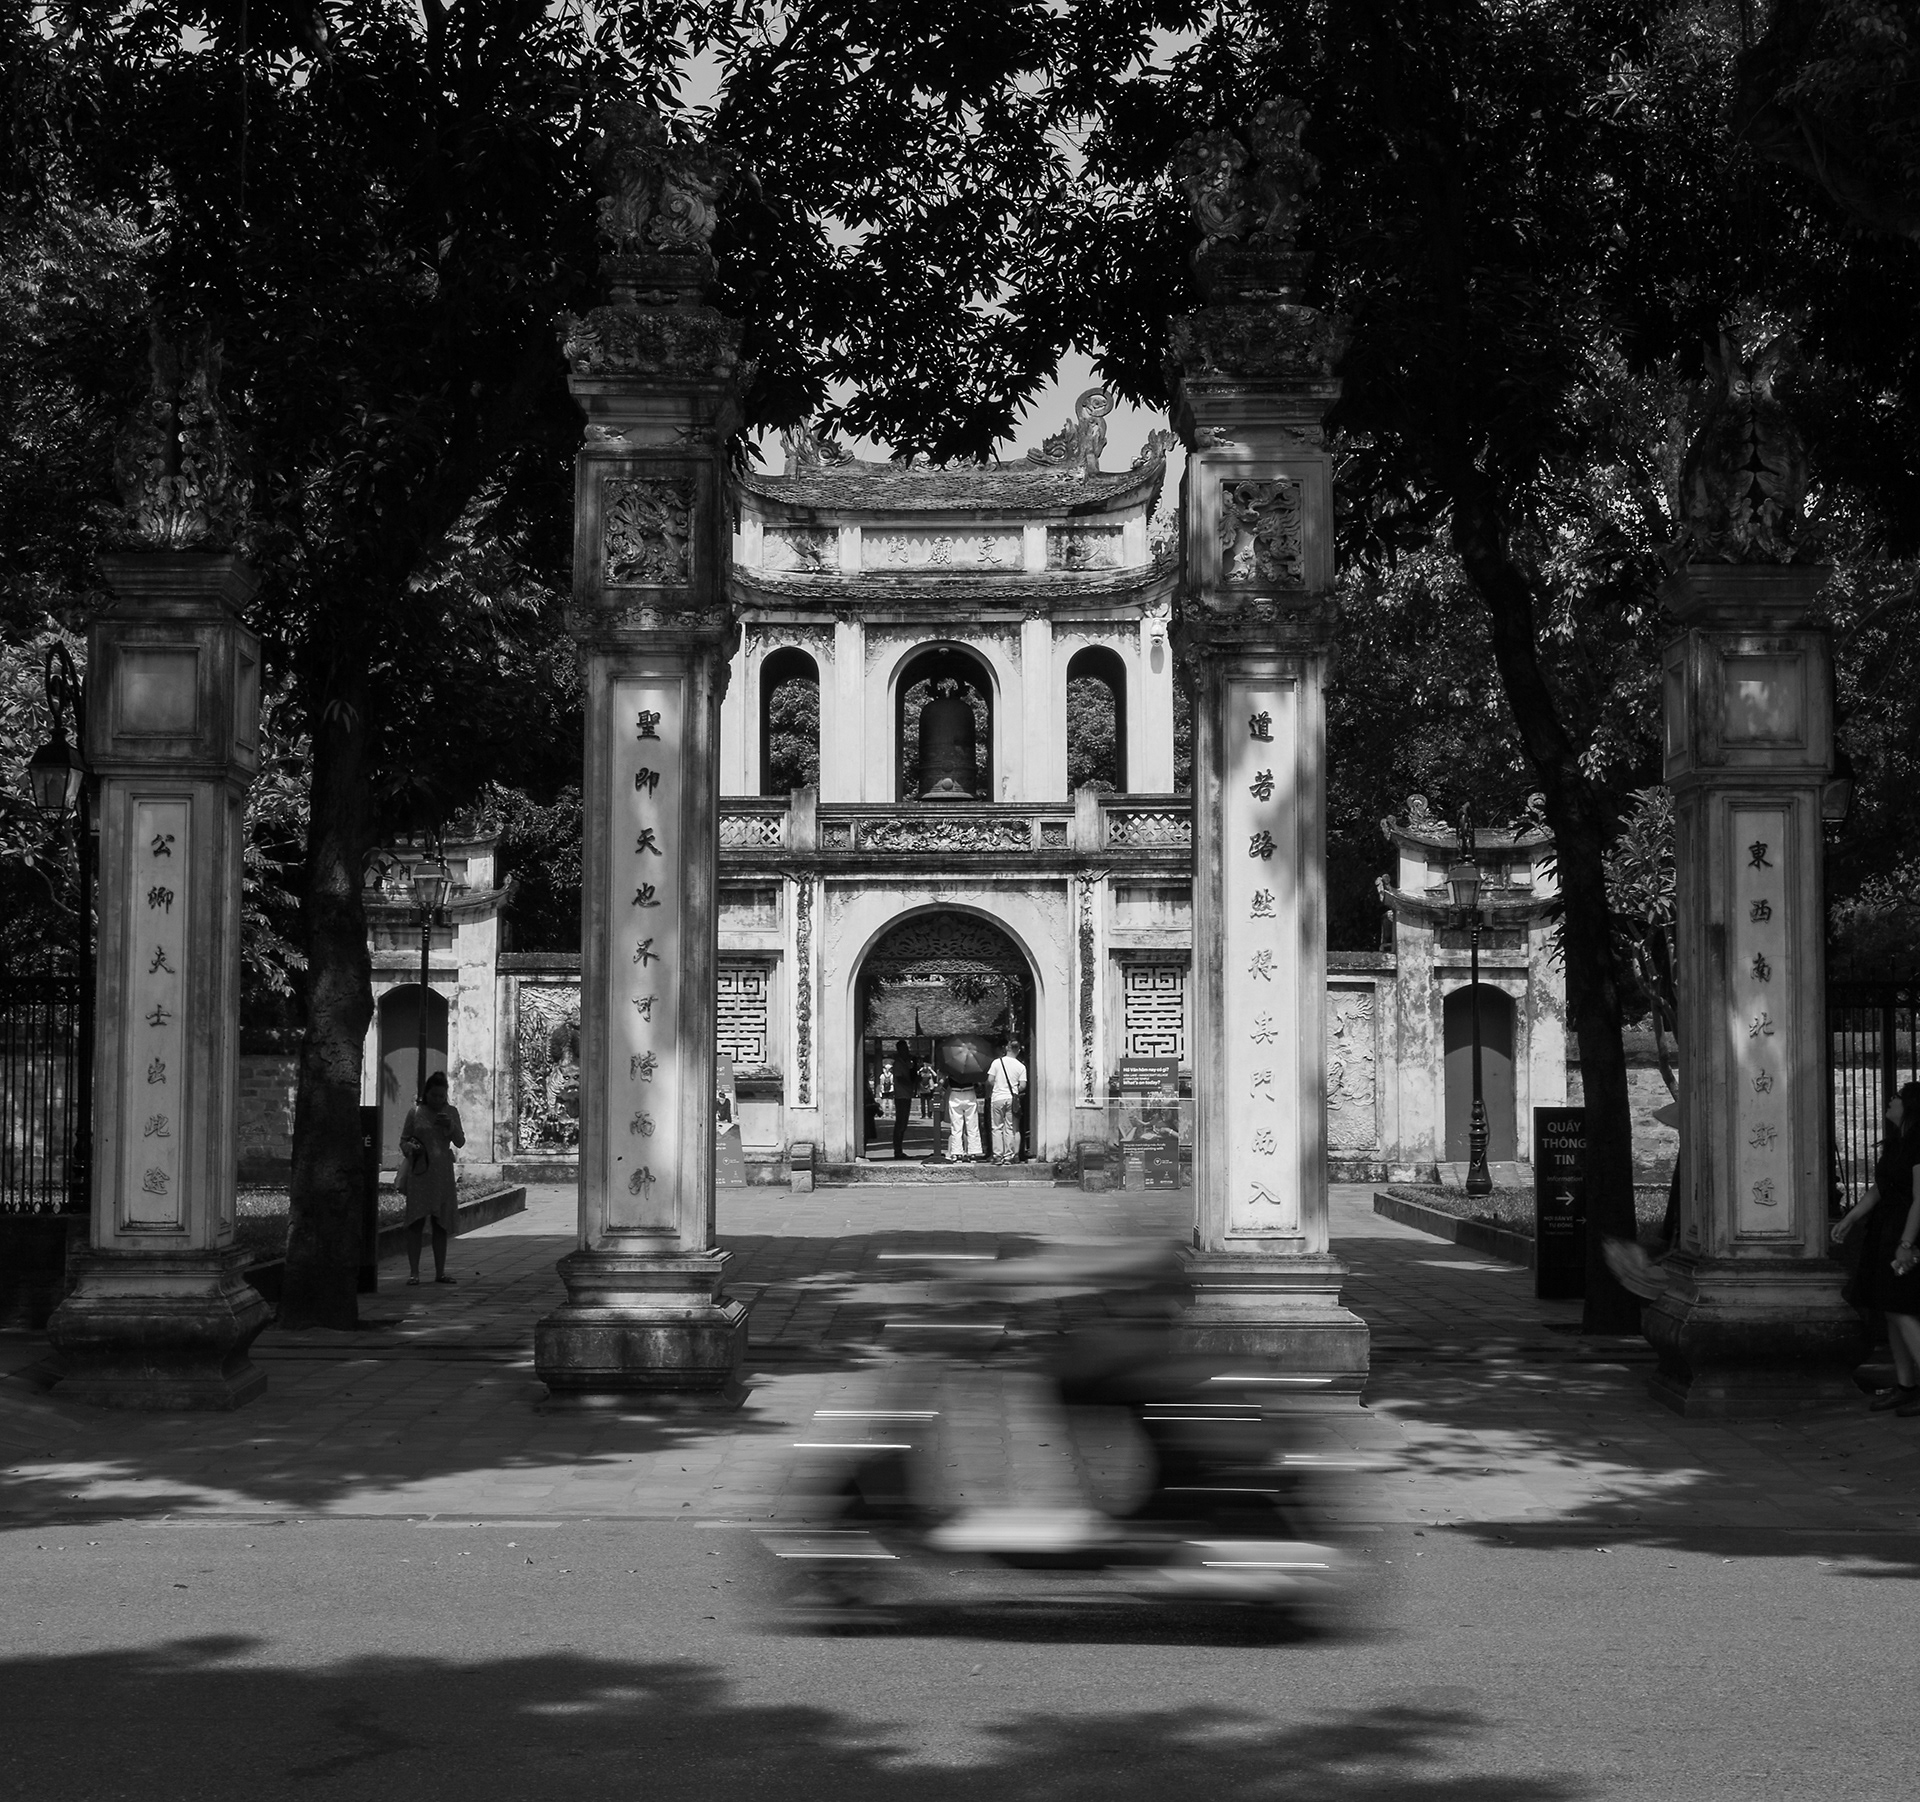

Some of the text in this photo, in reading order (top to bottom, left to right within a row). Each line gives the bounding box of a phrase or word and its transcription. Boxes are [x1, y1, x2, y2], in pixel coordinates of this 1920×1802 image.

[1542, 1136, 1587, 1149] THÔNG
[1554, 1154, 1575, 1165] TIN
[1546, 1174, 1583, 1182] Information
